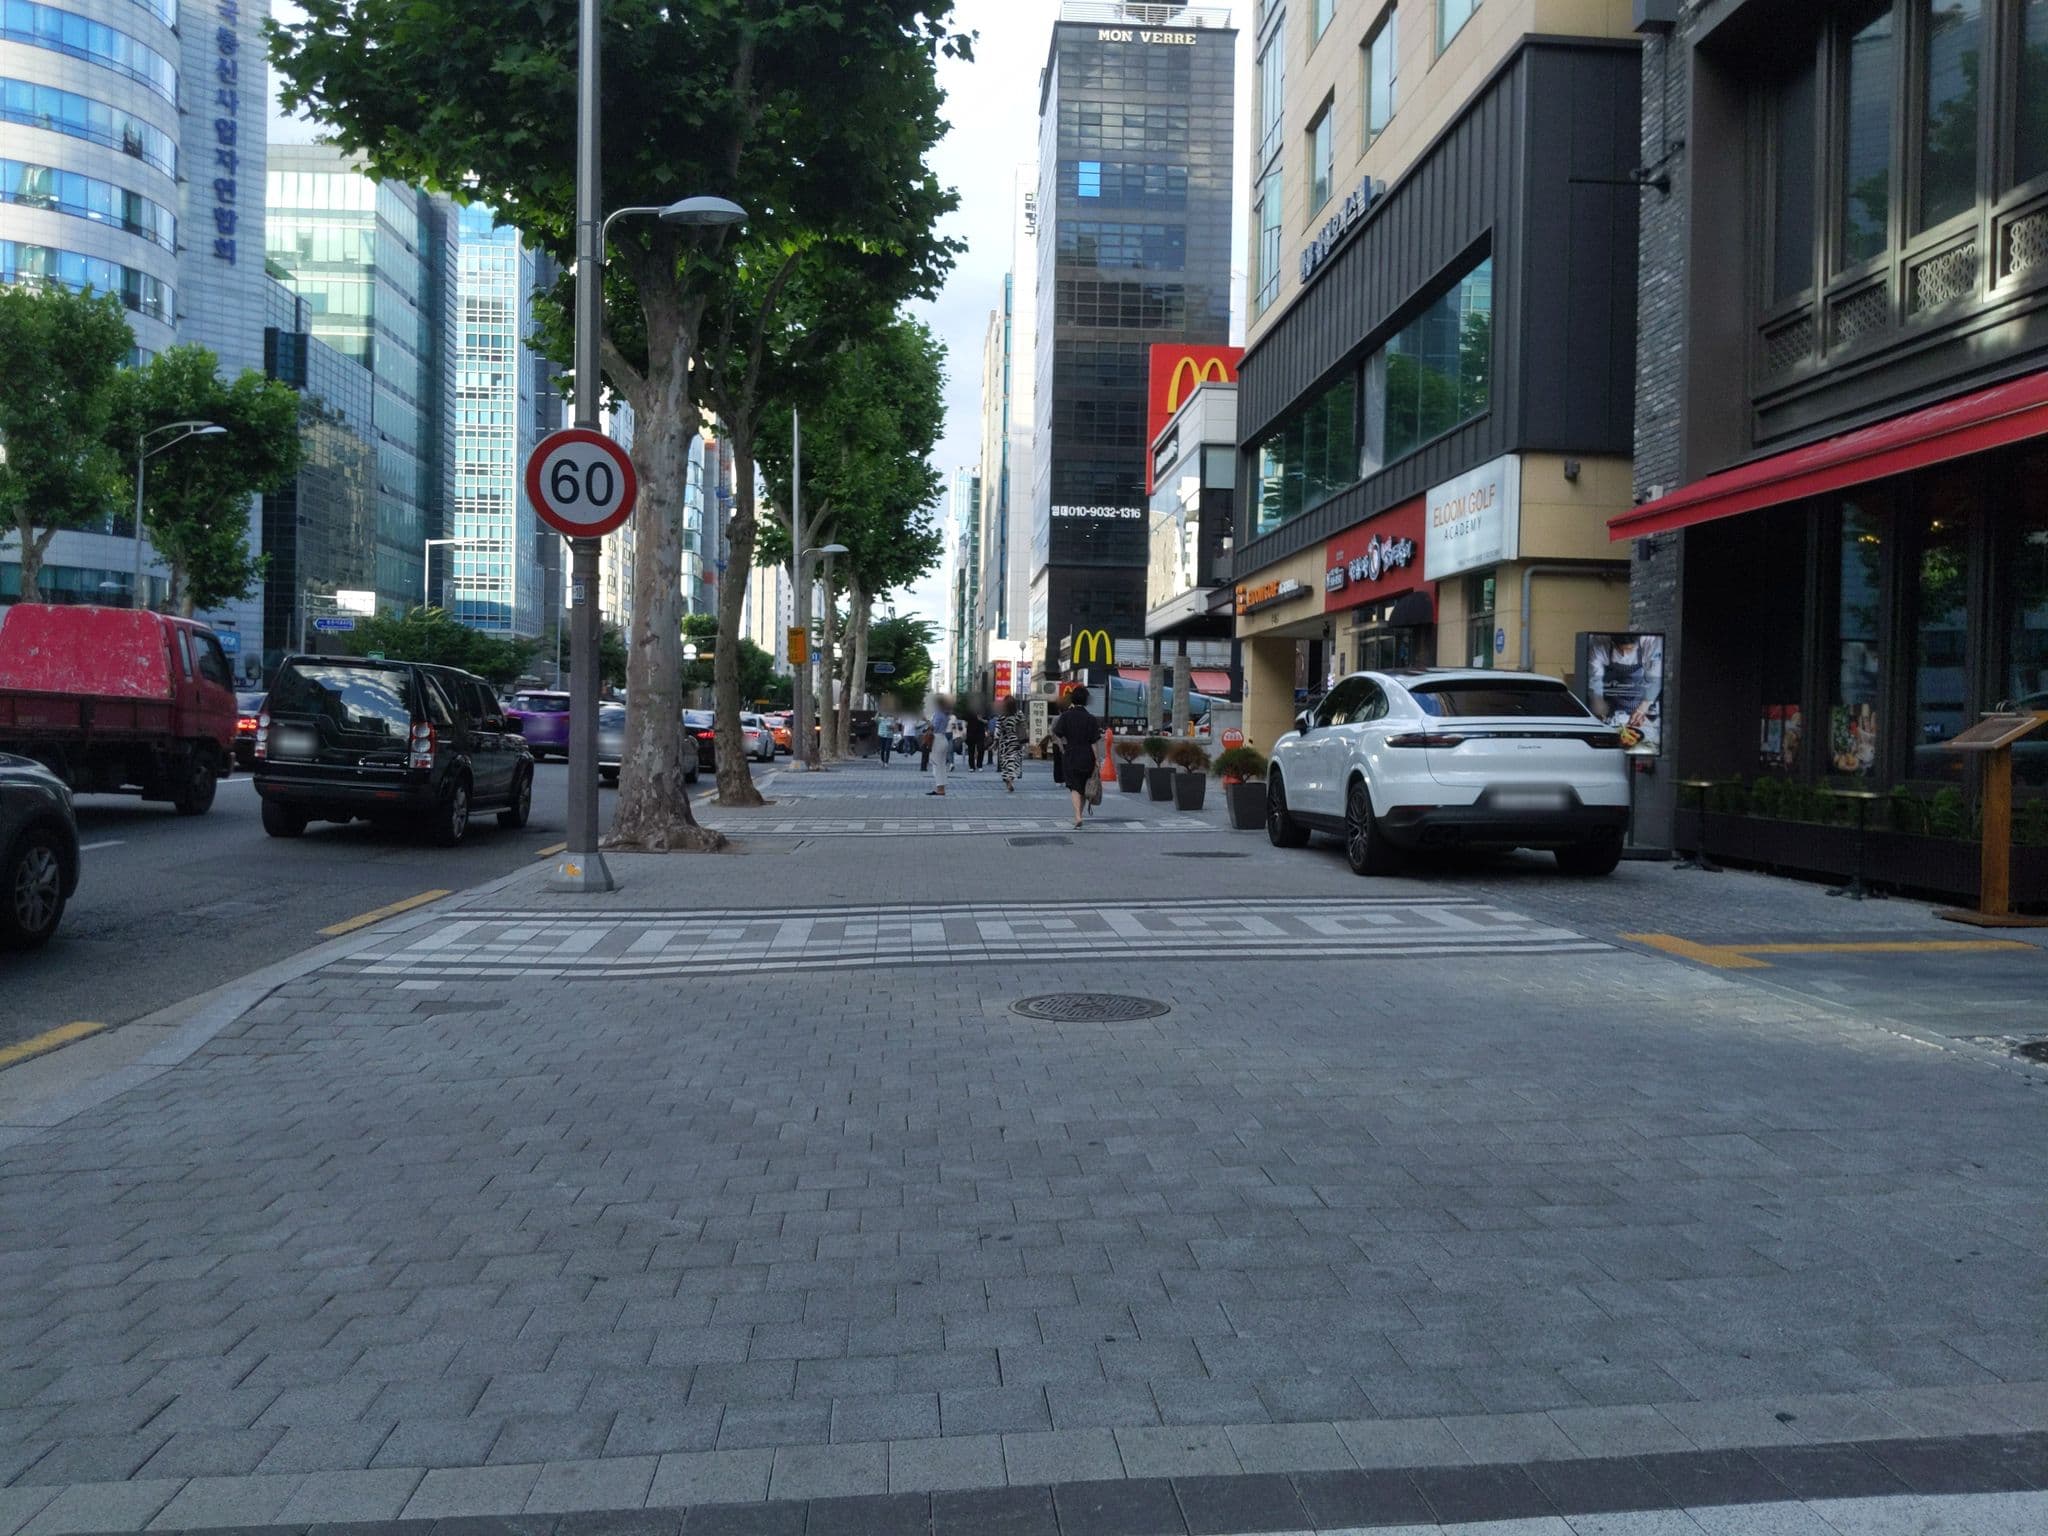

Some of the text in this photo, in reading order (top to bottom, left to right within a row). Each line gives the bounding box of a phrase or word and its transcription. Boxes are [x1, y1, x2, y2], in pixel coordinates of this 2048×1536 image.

[1097, 29, 1197, 45] MON VERRE
[551, 458, 614, 507] 60
[1433, 483, 1496, 529] ELOOM GOLF
[1443, 517, 1482, 541] ACADEMY
